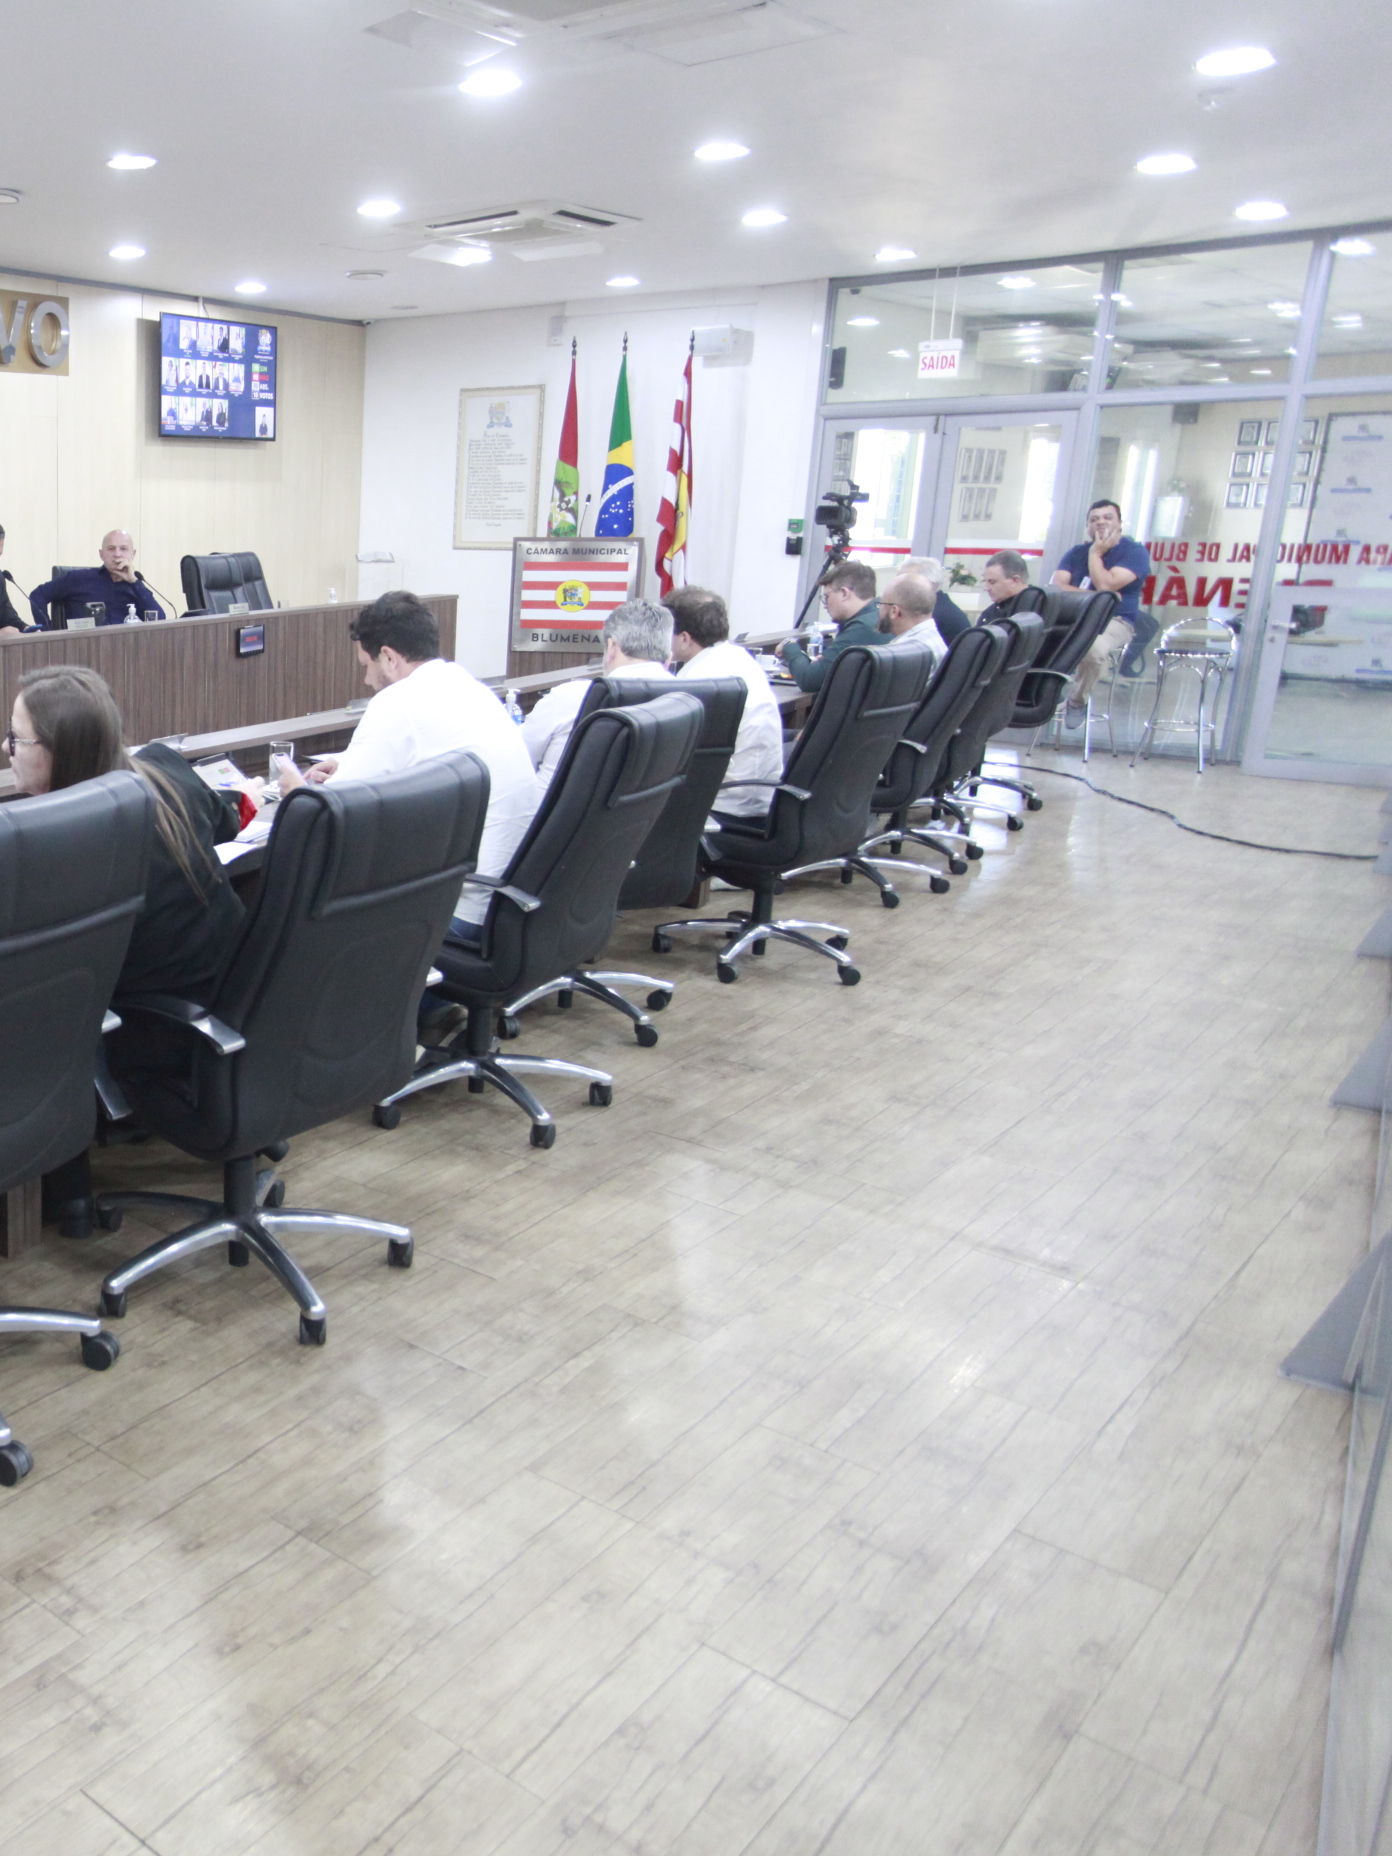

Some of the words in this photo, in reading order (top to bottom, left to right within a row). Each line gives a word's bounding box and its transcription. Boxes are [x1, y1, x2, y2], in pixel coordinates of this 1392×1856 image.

[920, 351, 956, 371] SAÍDA
[525, 546, 570, 556] CÂMARA
[571, 546, 630, 556] MUNICIPAL
[531, 632, 602, 644] BLUMENA
